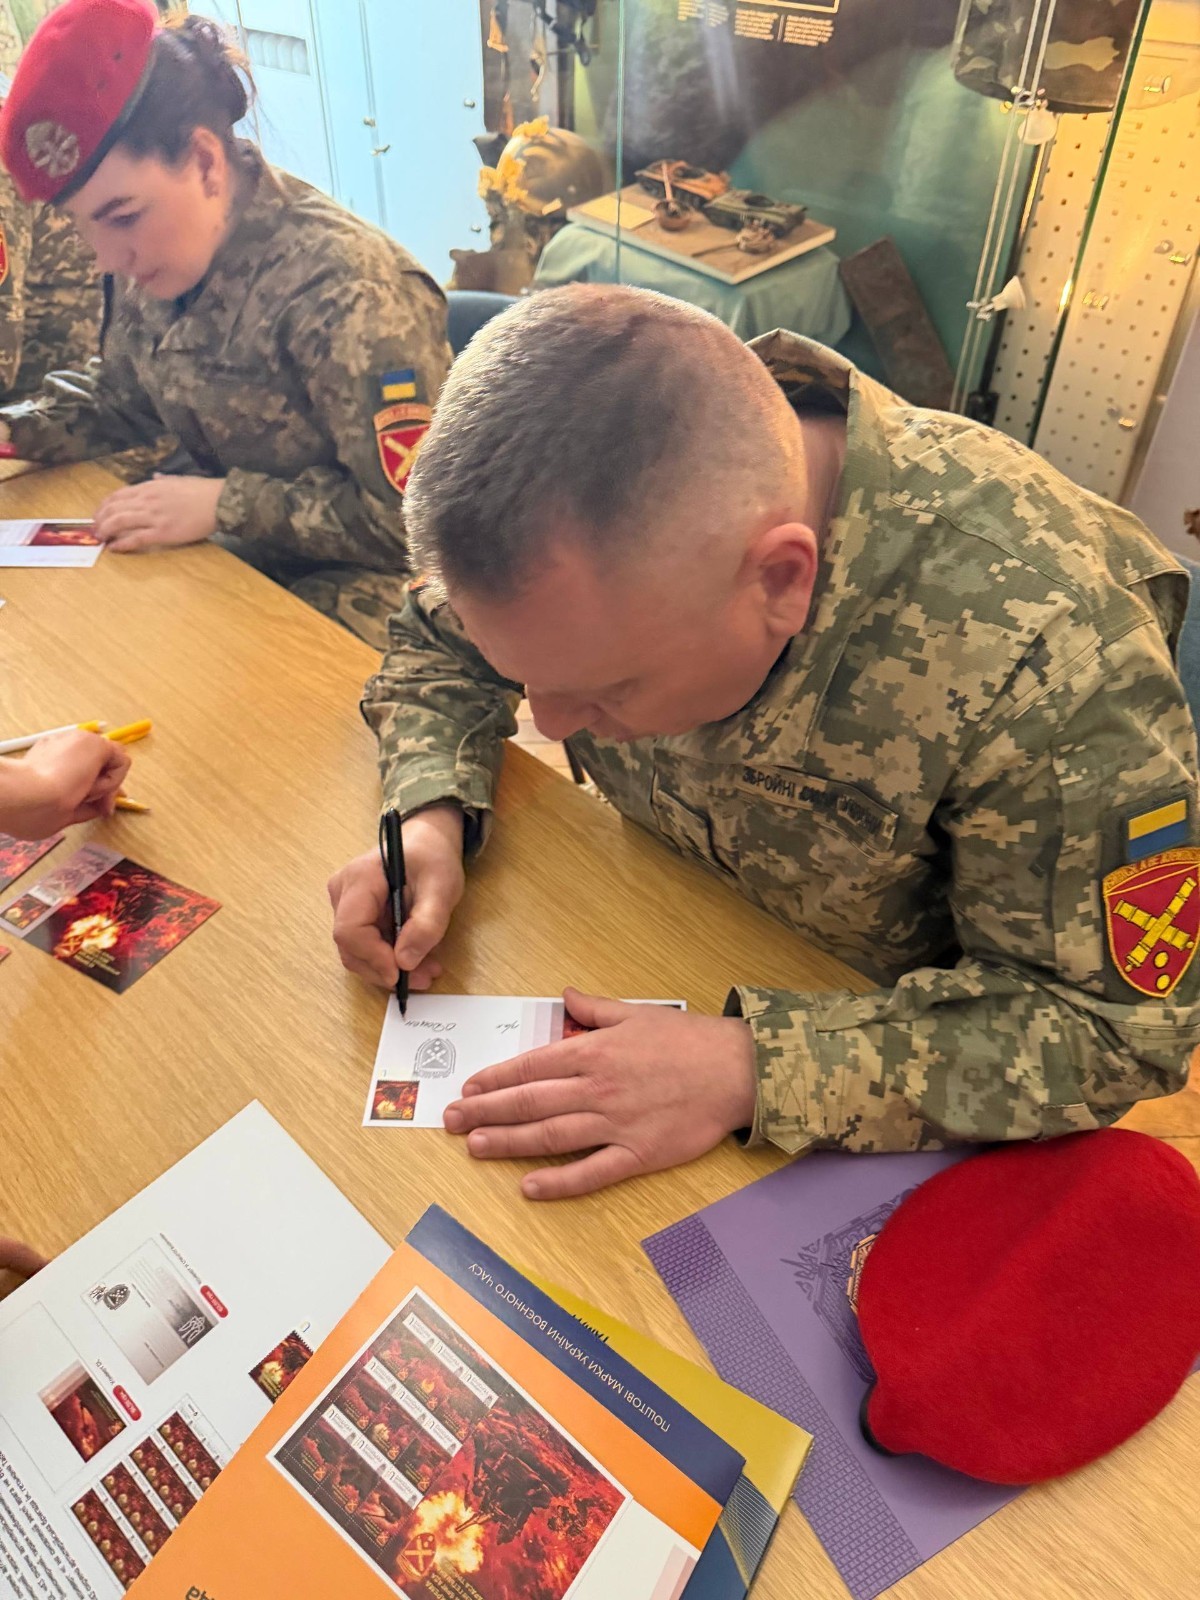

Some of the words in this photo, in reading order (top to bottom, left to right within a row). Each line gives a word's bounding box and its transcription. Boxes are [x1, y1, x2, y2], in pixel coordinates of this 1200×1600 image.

[467, 1262, 494, 1286] ЧАСУ
[493, 1282, 549, 1330] ВОЄННОГО
[546, 1328, 590, 1365] УКРАЇНИ
[587, 1360, 625, 1393] МАРКИ
[622, 1391, 671, 1432] ПОШТОВІ
[27, 1500, 48, 1525] бригада
